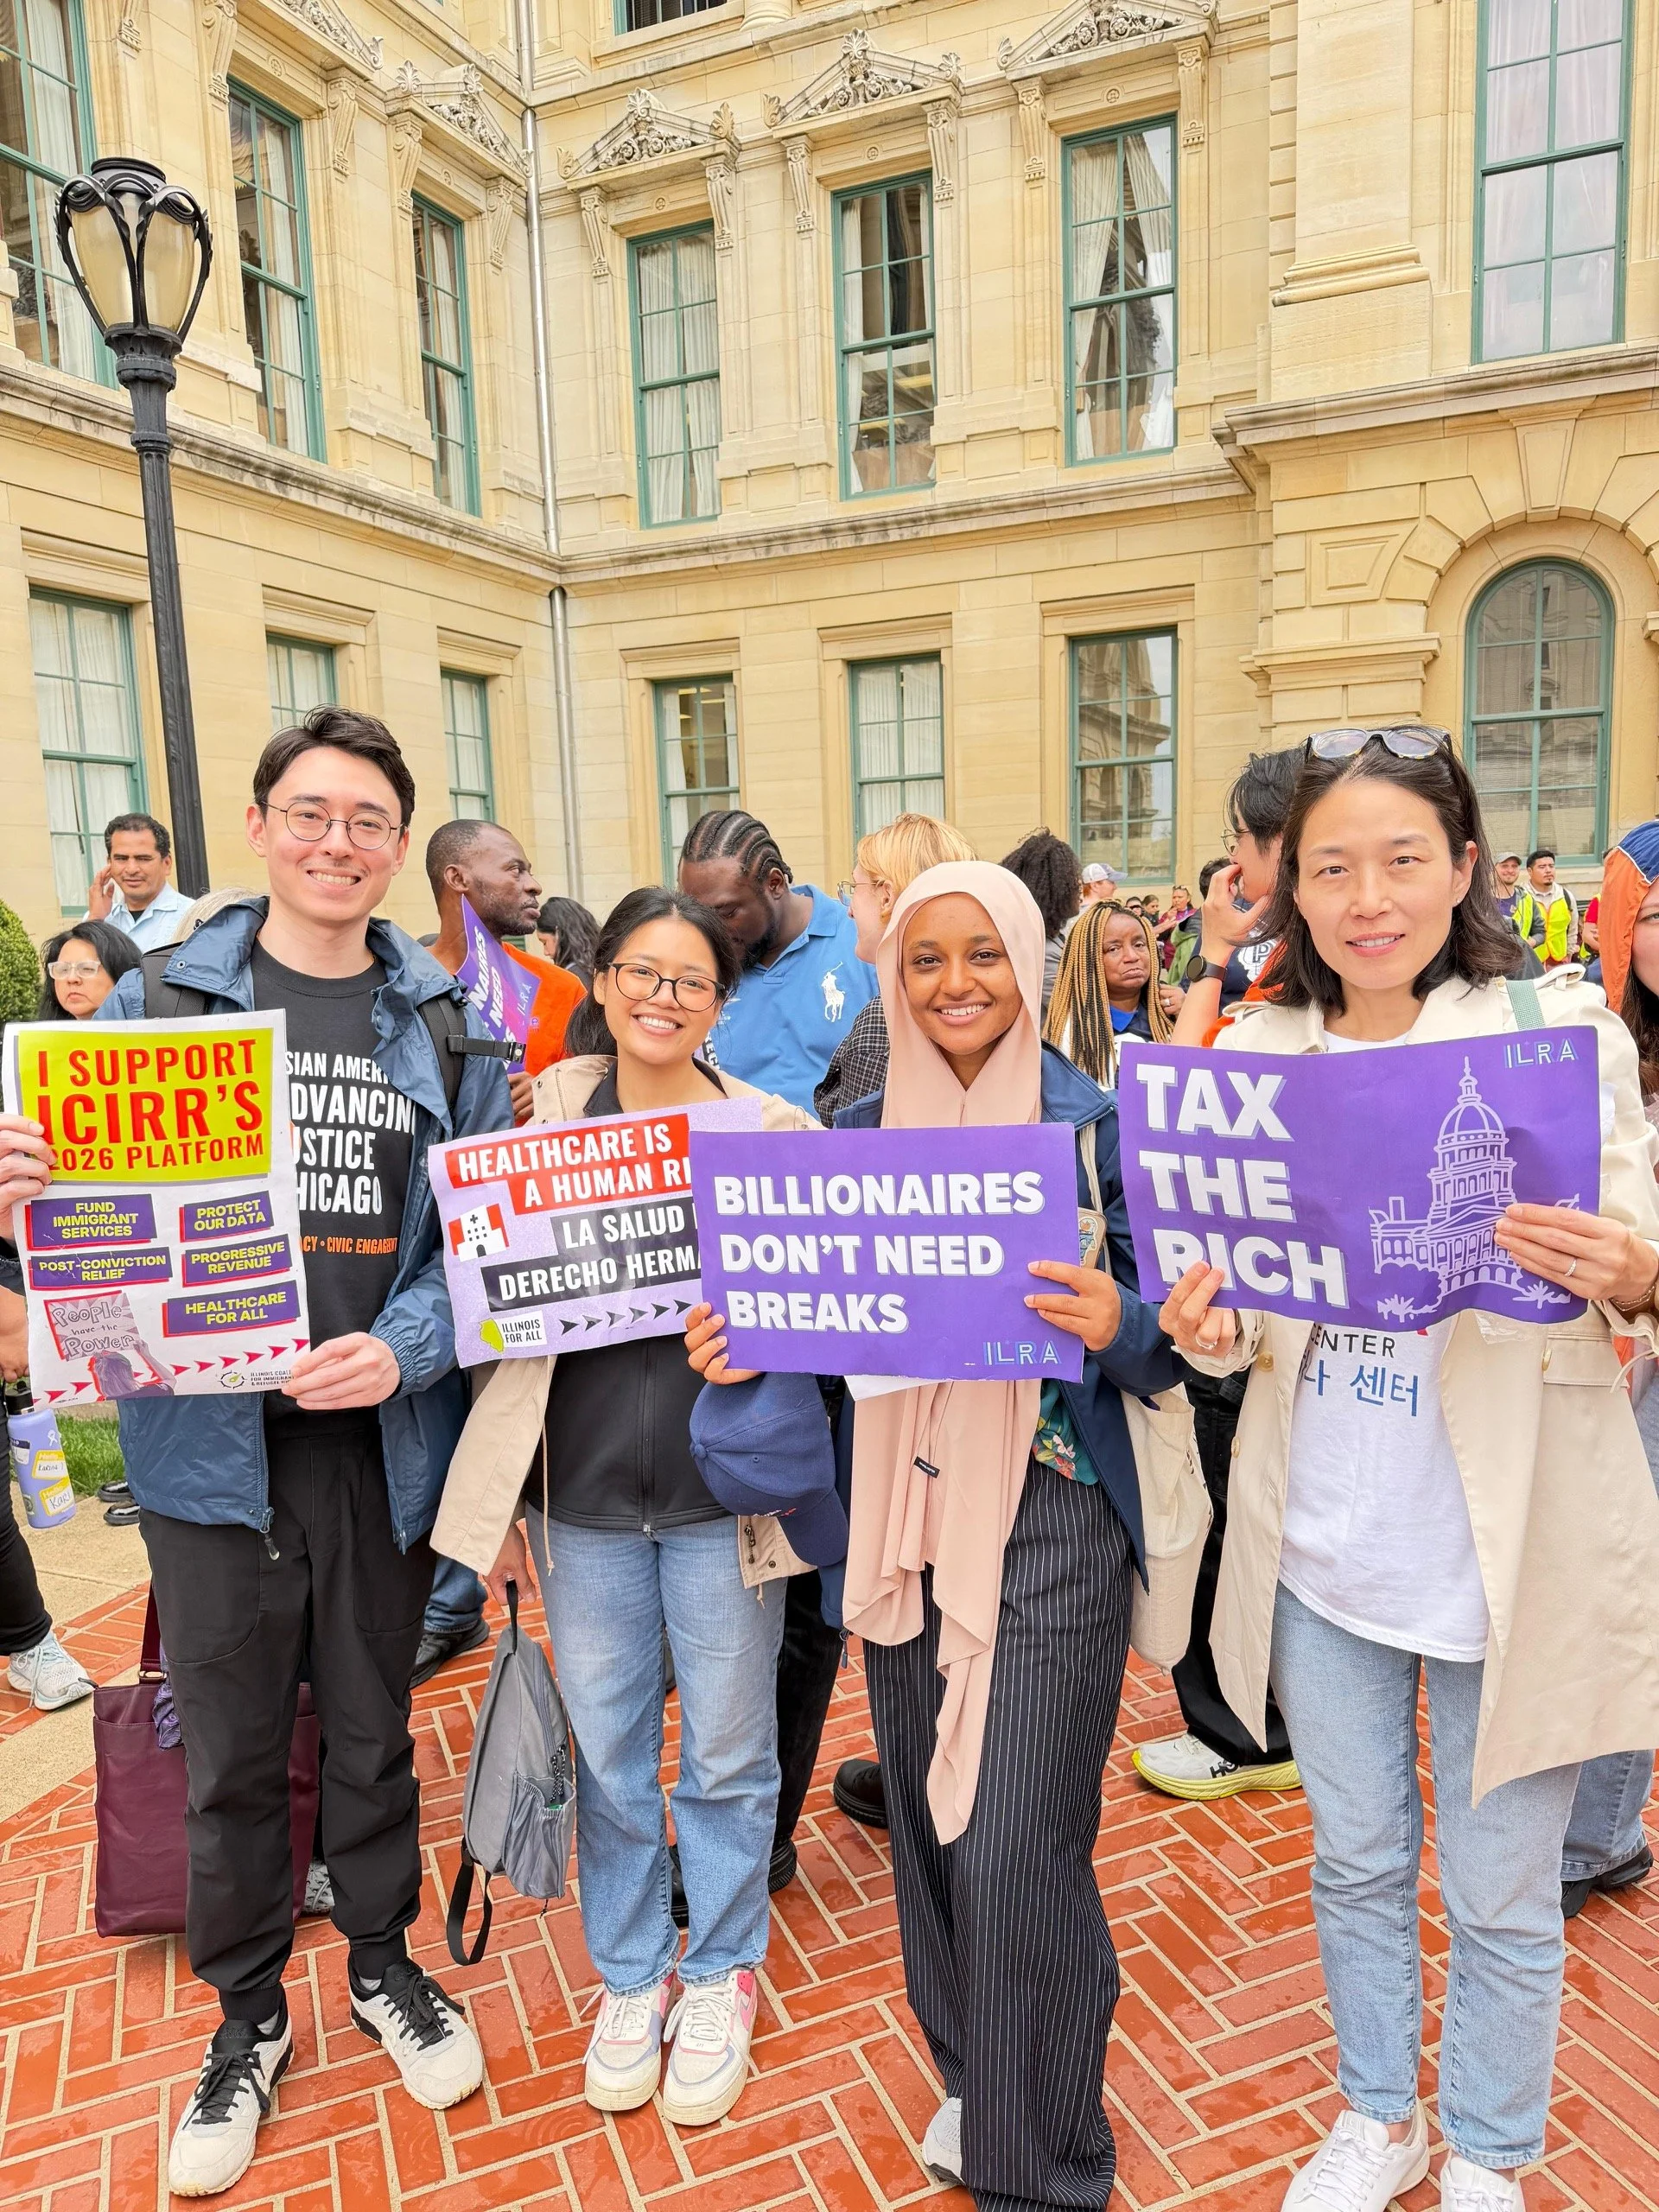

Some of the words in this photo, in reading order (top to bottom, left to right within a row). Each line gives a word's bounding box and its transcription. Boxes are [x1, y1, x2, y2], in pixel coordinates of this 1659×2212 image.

[517, 983, 532, 1015] ILRA
[38, 1051, 49, 1088] I
[69, 1039, 257, 1088] SUPPORT
[332, 1053, 389, 1084] AMER
[1503, 1039, 1579, 1070] ILRA
[290, 1082, 416, 1136] DVANCIN
[1135, 1063, 1295, 1142] TAX
[127, 1132, 264, 1170] PLATFORM
[458, 1127, 638, 1183] HEALTHCARE
[644, 1122, 672, 1154] IS
[524, 1178, 543, 1209] A
[551, 1161, 653, 1204] HUMAN
[713, 1171, 1046, 1217] BILLIONAIRES
[1139, 1150, 1297, 1224] THE
[53, 1213, 139, 1229] IMMIGRANT
[75, 1201, 117, 1215] FUND
[194, 1217, 226, 1232] OUR
[226, 1210, 266, 1229] DATA
[196, 1199, 262, 1220] PROTECT
[61, 1225, 133, 1240] SERVICES
[563, 1217, 596, 1249] LA
[603, 1205, 686, 1243] SALUD
[191, 1241, 286, 1265] PROGRESSIVE
[300, 1235, 319, 1253] CY
[327, 1236, 354, 1254] CIVIC
[719, 1233, 862, 1274] DON'T
[874, 1234, 1005, 1277] NEED
[39, 1255, 167, 1272] POST-CONVICTION
[81, 1268, 126, 1281] RELIEF
[207, 1256, 272, 1275] REVENUE
[498, 1257, 618, 1302] DERECHO
[626, 1244, 702, 1281] HERM
[1153, 1229, 1350, 1310] RICH
[185, 1291, 288, 1315] HEALTHCARE
[207, 1310, 238, 1325] FOR
[239, 1307, 269, 1322] ALL
[725, 1290, 909, 1334] BREAKS
[71, 1326, 96, 1336] have
[501, 1318, 541, 1333] ILLINOIS
[505, 1329, 524, 1344] FOR
[525, 1326, 543, 1342] ALL
[982, 1339, 1063, 1366] ILRA
[1349, 1363, 1419, 1417] 센터
[1210, 1759, 1243, 1779] HO
